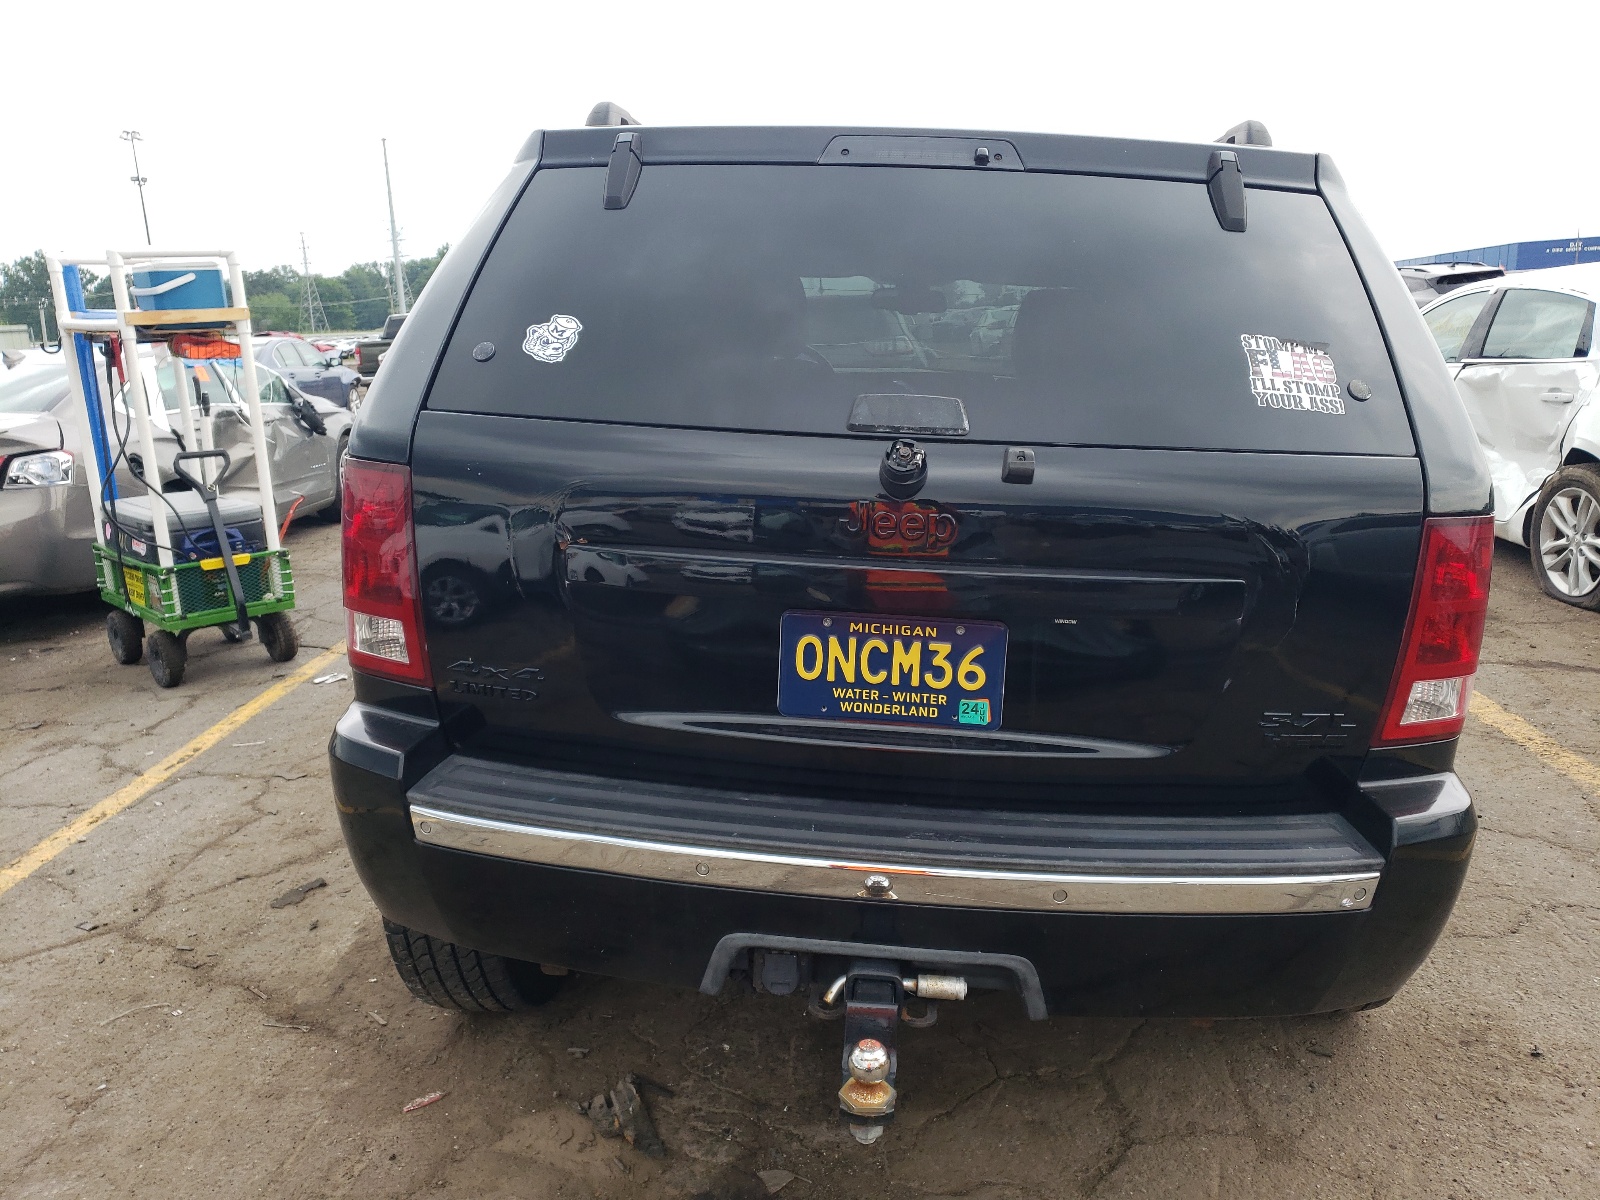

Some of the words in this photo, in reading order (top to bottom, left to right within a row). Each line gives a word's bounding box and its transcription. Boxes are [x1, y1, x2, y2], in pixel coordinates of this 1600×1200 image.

[1247, 349, 1336, 383] FLAG
[1282, 380, 1340, 399] STOMP
[1255, 391, 1307, 410] YOUR
[1308, 396, 1345, 414] ASS!
[840, 500, 958, 551] Jeep
[849, 622, 938, 638] MICHIGAN
[832, 687, 879, 701] WATER
[892, 691, 948, 706] WINTER
[840, 701, 939, 719] WONDERLAND
[961, 702, 980, 715] 24
